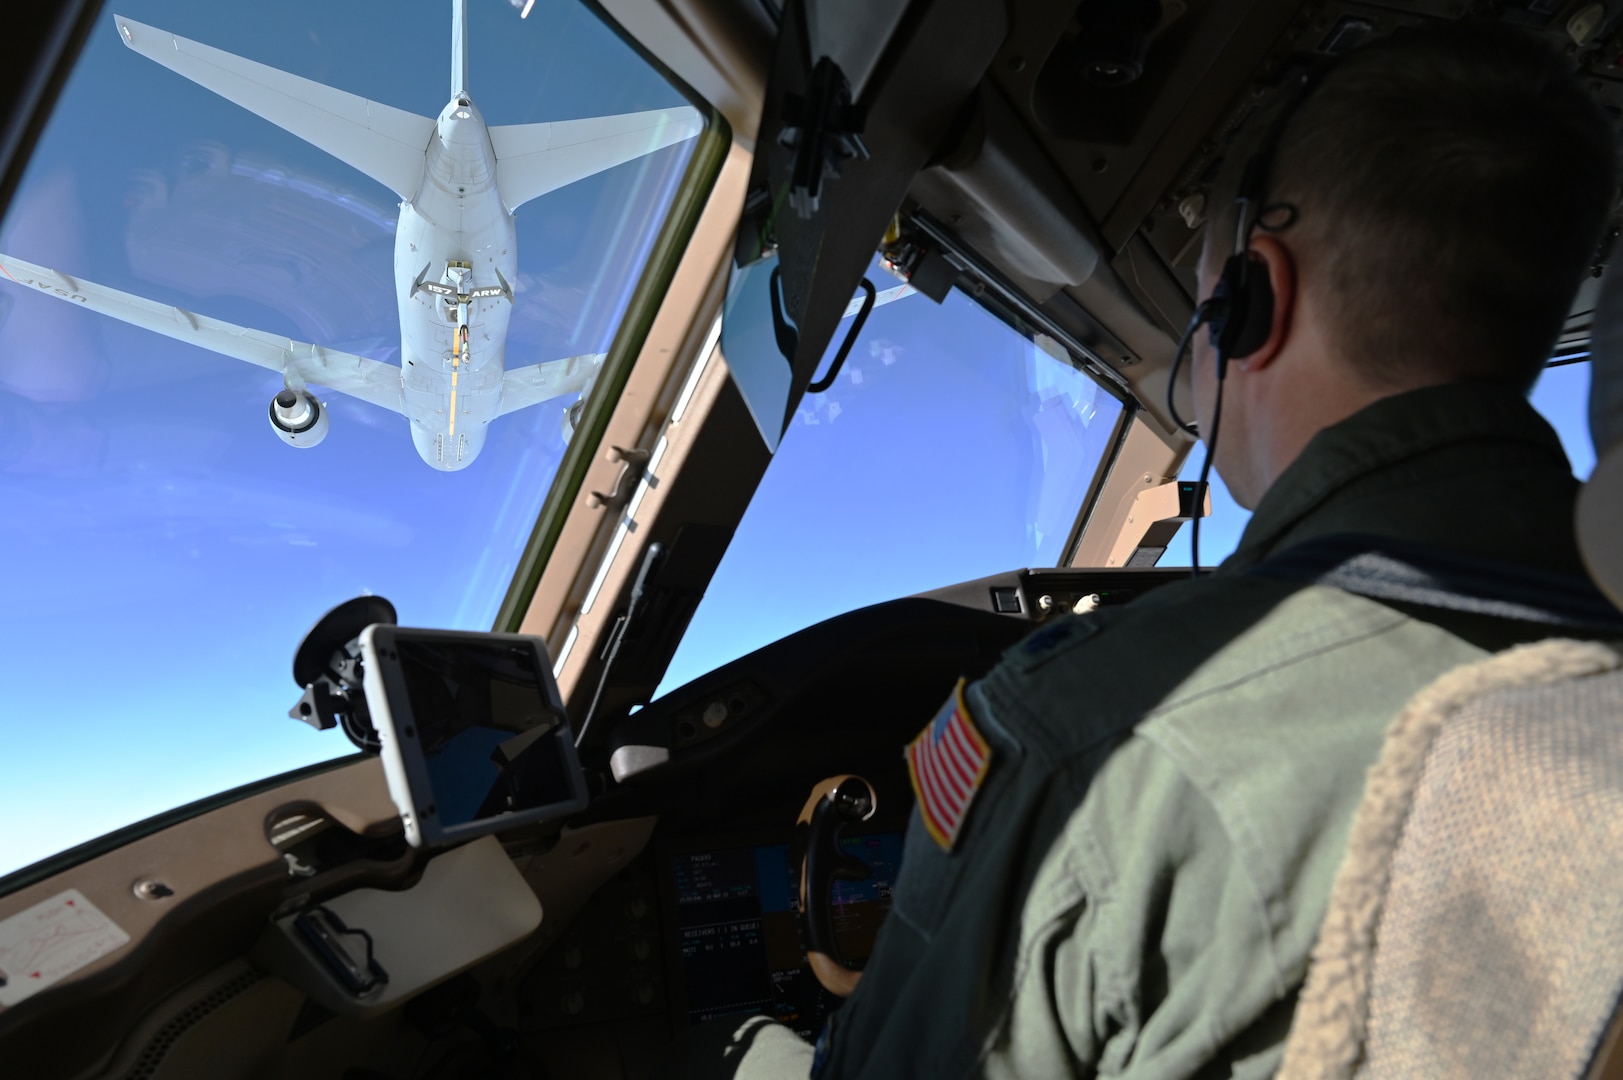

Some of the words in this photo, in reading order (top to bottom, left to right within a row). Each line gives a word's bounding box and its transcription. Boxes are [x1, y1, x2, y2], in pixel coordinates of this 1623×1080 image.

[17, 278, 88, 303] USAF
[427, 284, 453, 295] 157
[471, 288, 502, 298] ARW
